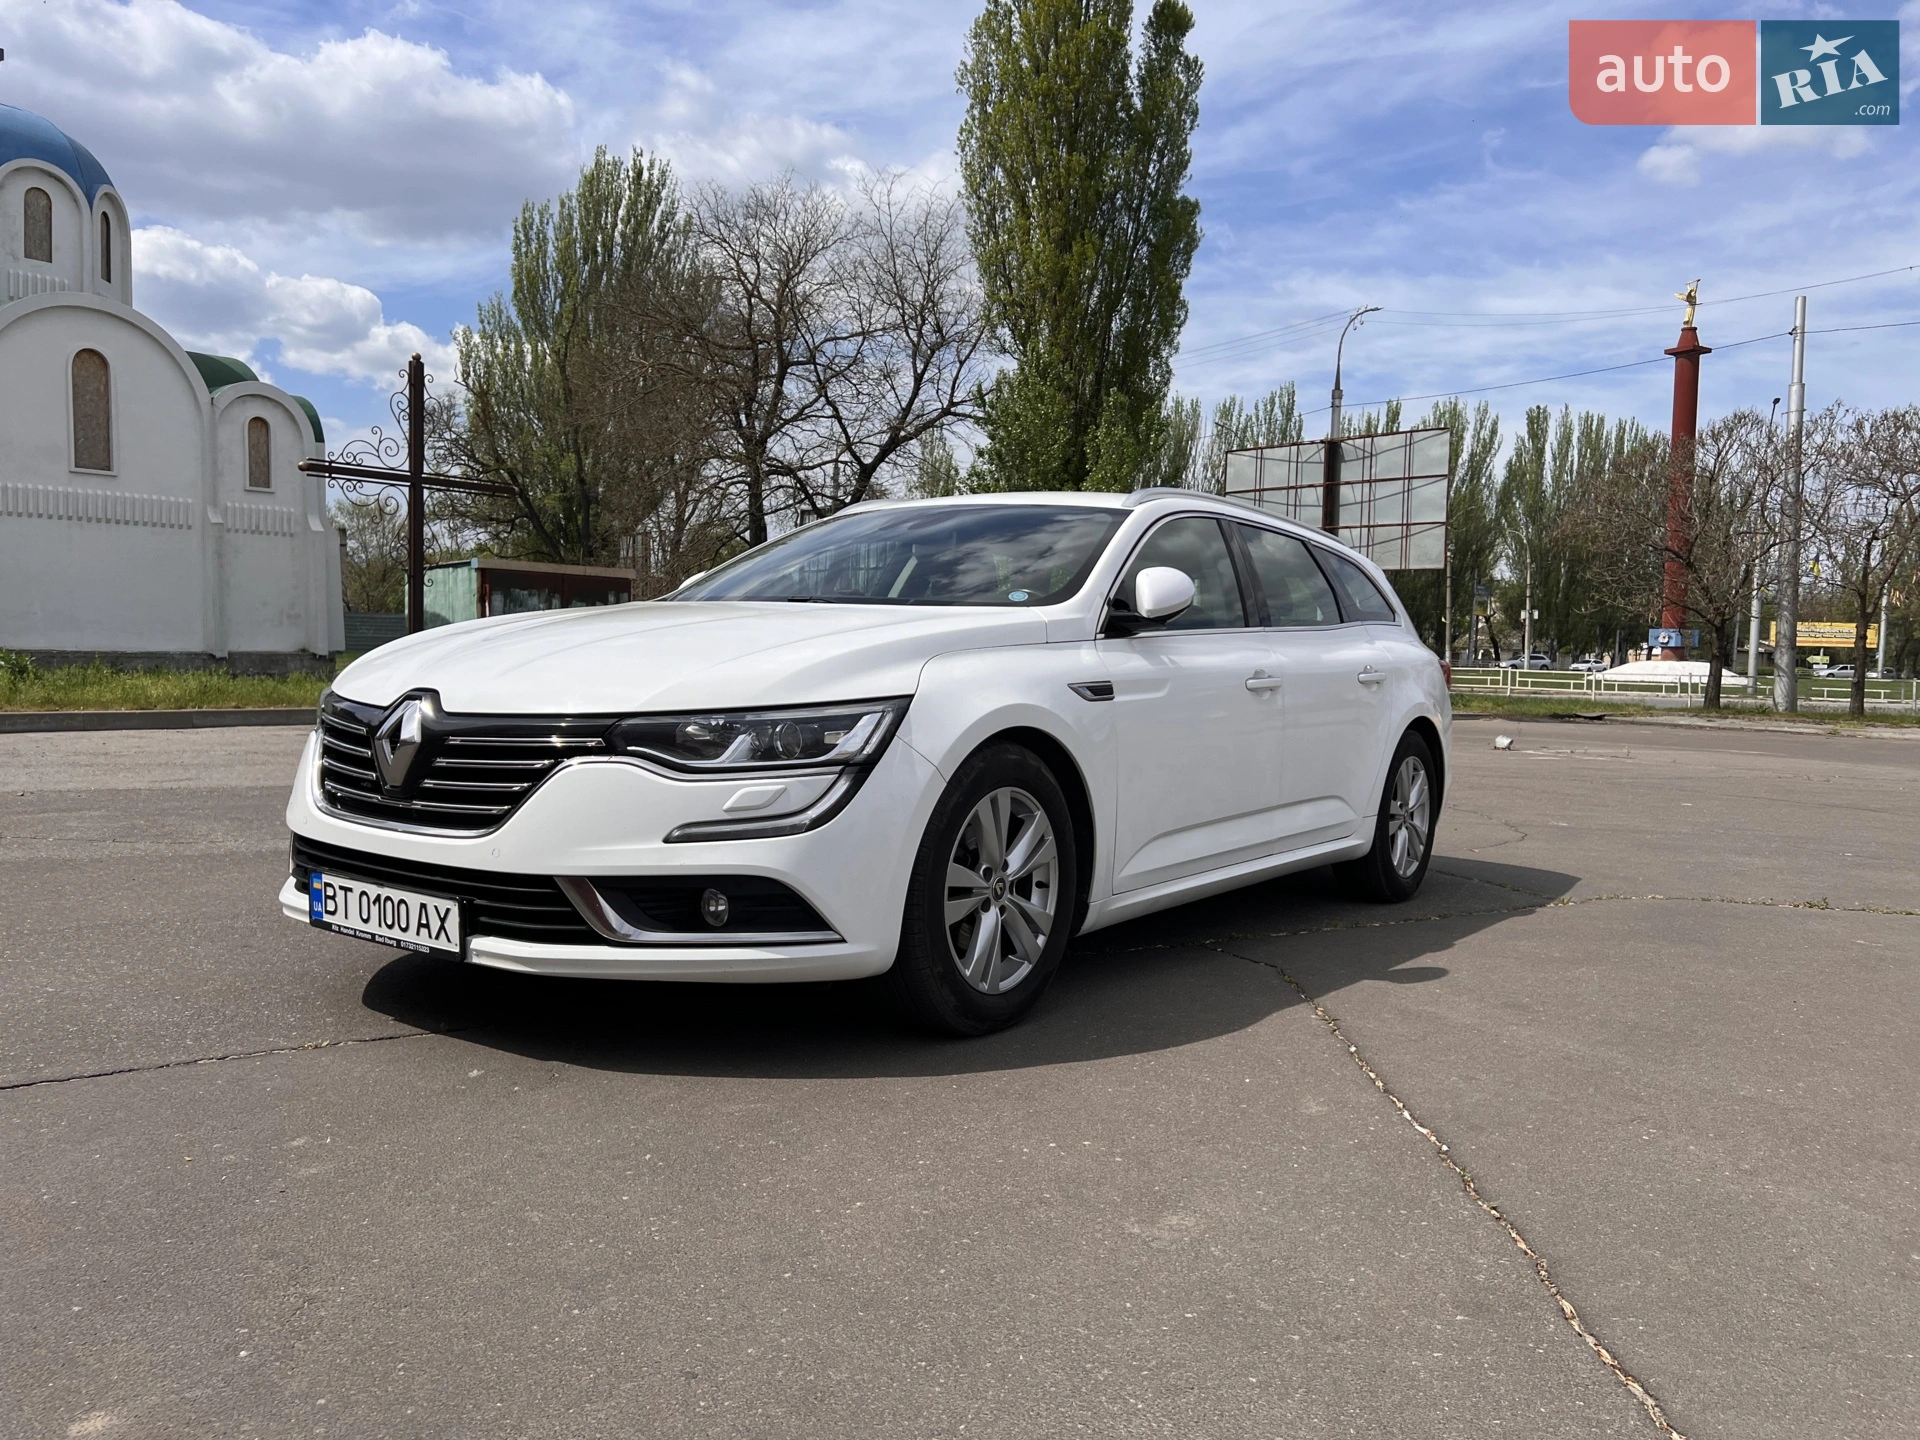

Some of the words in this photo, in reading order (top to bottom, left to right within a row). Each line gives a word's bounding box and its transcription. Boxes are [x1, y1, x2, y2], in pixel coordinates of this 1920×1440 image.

[313, 901, 322, 912] UA
[323, 881, 353, 919] BT
[358, 890, 409, 932] 0100
[416, 902, 452, 943] AX
[341, 927, 355, 935] Handel
[375, 935, 384, 943] Bad
